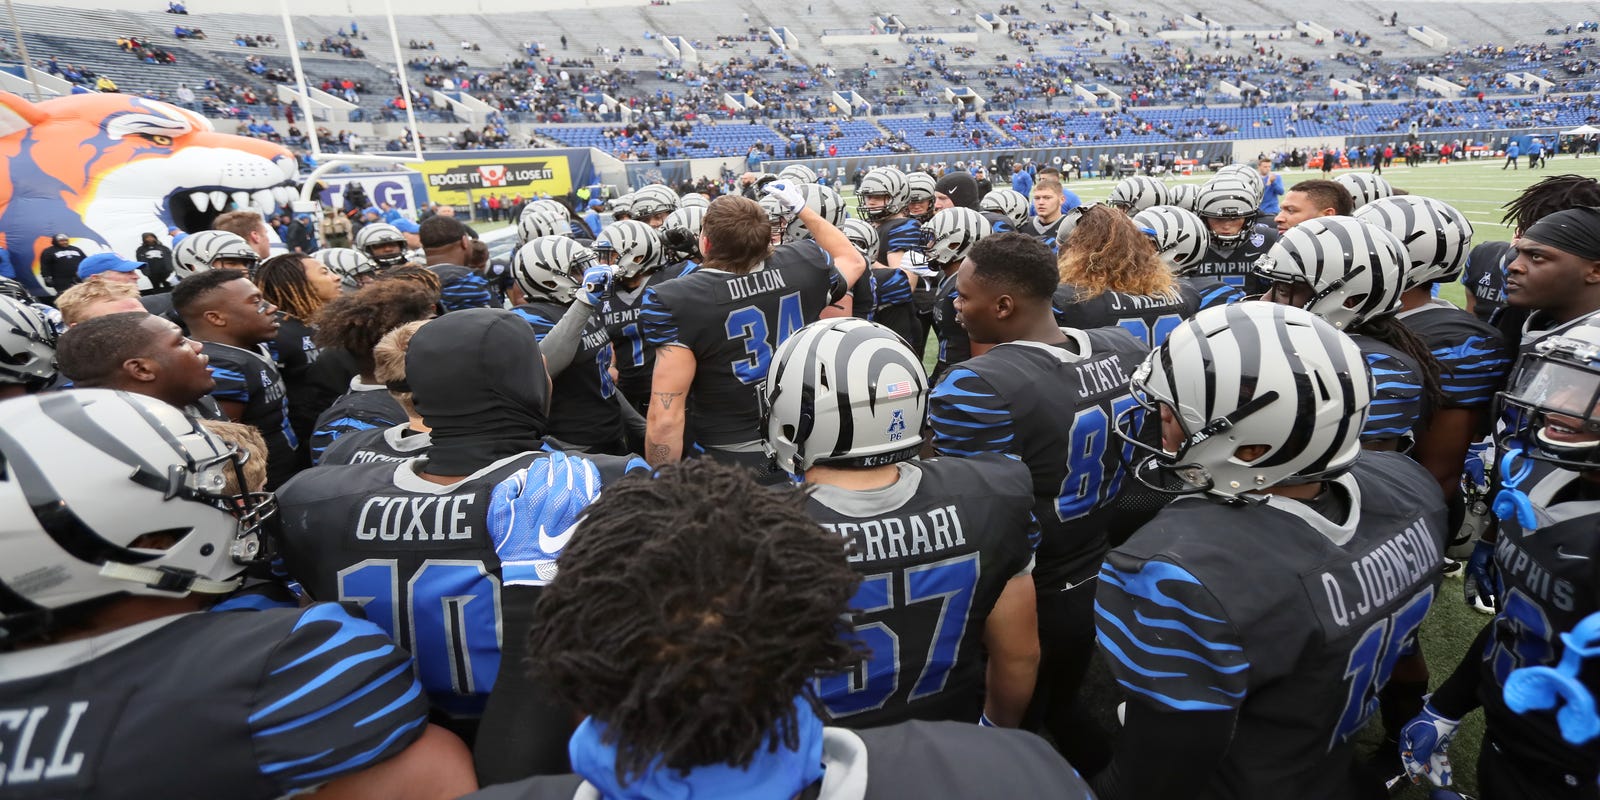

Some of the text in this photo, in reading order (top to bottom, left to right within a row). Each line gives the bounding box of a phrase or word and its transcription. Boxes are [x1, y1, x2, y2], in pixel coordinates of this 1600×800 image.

[317, 181, 408, 210] TG
[429, 168, 553, 186] BOOZE IT & LOSE IT
[726, 269, 787, 301] DILLON
[724, 291, 805, 385] 34
[355, 493, 476, 541] COXIE
[818, 504, 967, 563] ERRARI
[337, 558, 504, 718] 10
[814, 550, 981, 719] 57
[0, 700, 90, 785] ELL
